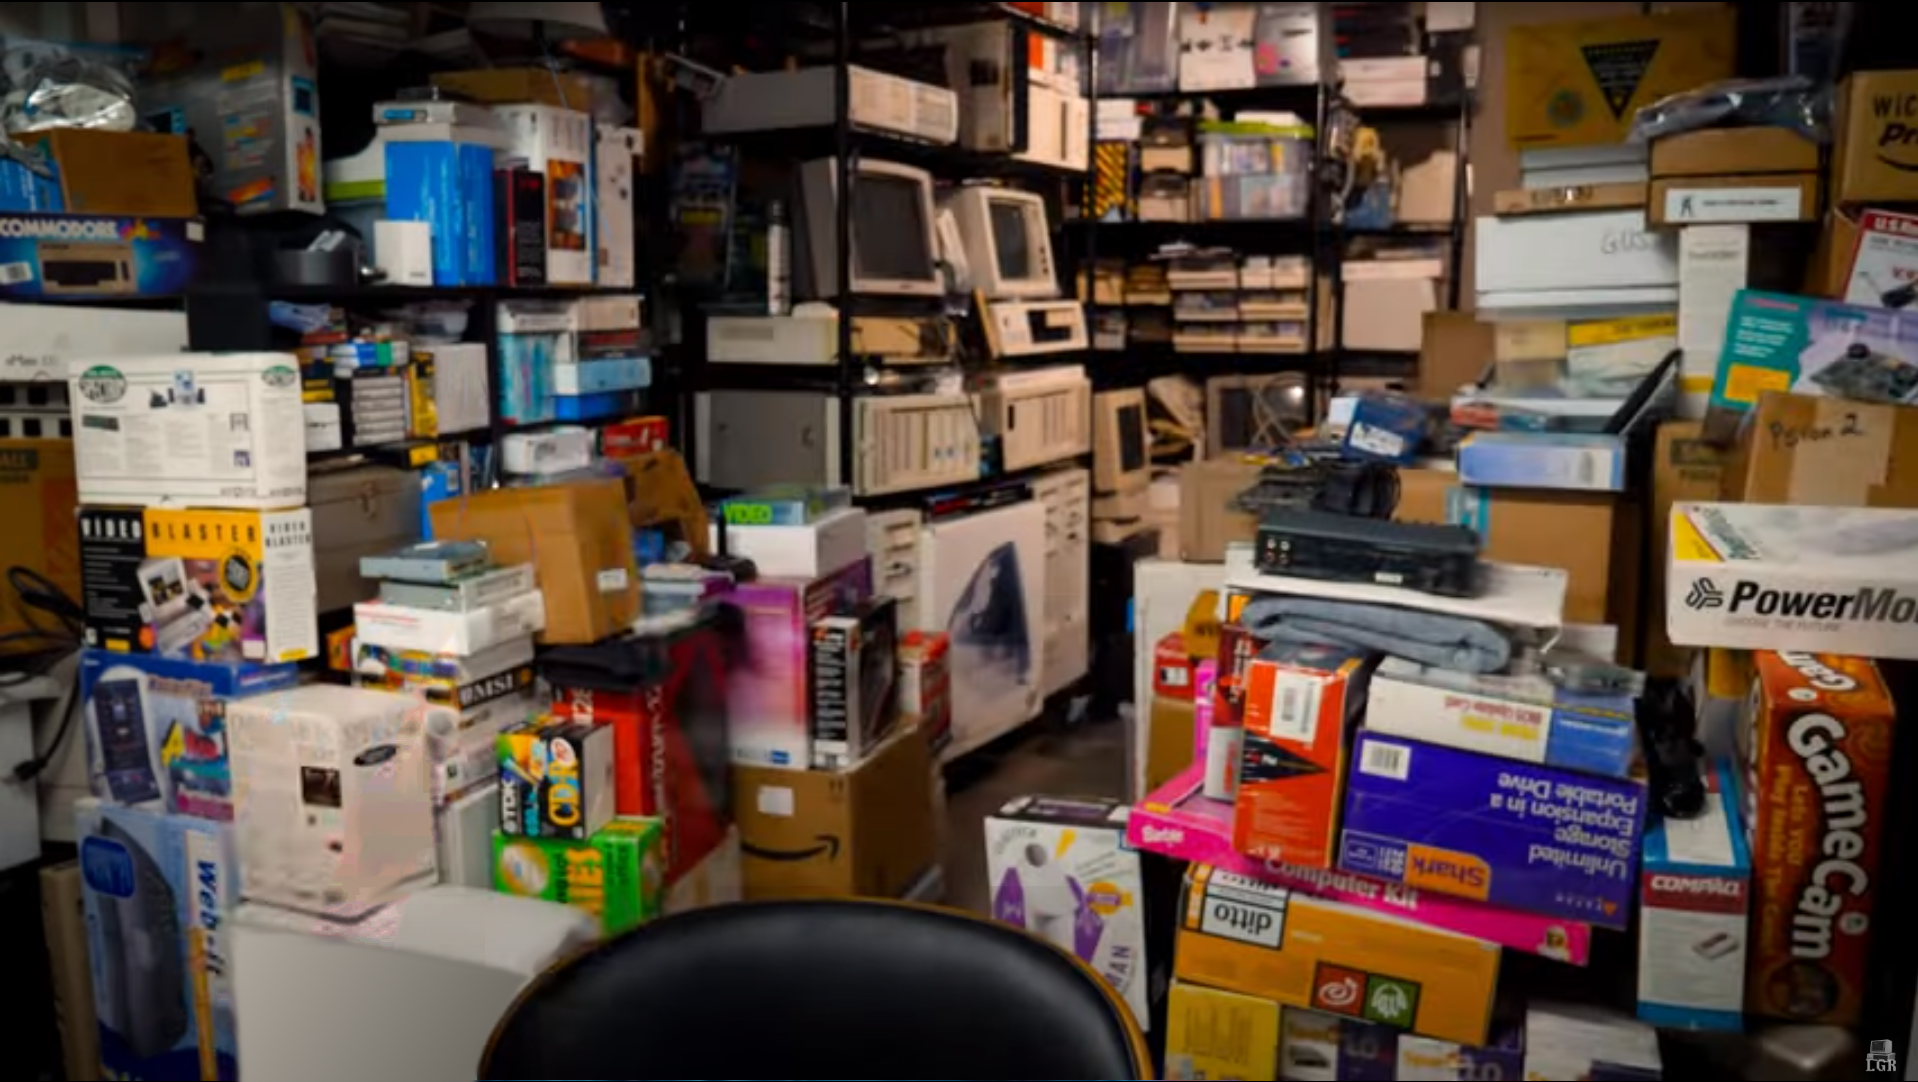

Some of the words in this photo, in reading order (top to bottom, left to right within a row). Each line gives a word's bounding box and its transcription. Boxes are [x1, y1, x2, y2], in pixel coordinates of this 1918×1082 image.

[0, 217, 119, 238] COMMODORE
[1840, 413, 1863, 435] 2
[722, 504, 773, 524] VIDEO
[81, 517, 141, 538] VIDEO
[151, 521, 256, 542] BLASTER
[264, 533, 312, 547] BLASTER
[269, 521, 306, 534] VIDEO
[1498, 772, 1551, 799] Drive
[1490, 793, 1502, 808] a
[1506, 801, 1526, 819] in
[1555, 783, 1638, 815] Portable
[1530, 799, 1634, 836] Expansion
[1554, 823, 1632, 858] Storage
[1786, 712, 1869, 959] GameCam
[1411, 857, 1486, 888] Shark
[1528, 845, 1627, 879] Unlimited
[1264, 856, 1380, 898] Computer
[1382, 883, 1419, 910] Kit
[1651, 874, 1740, 896] COMPAQ
[1213, 902, 1272, 936] ditto
